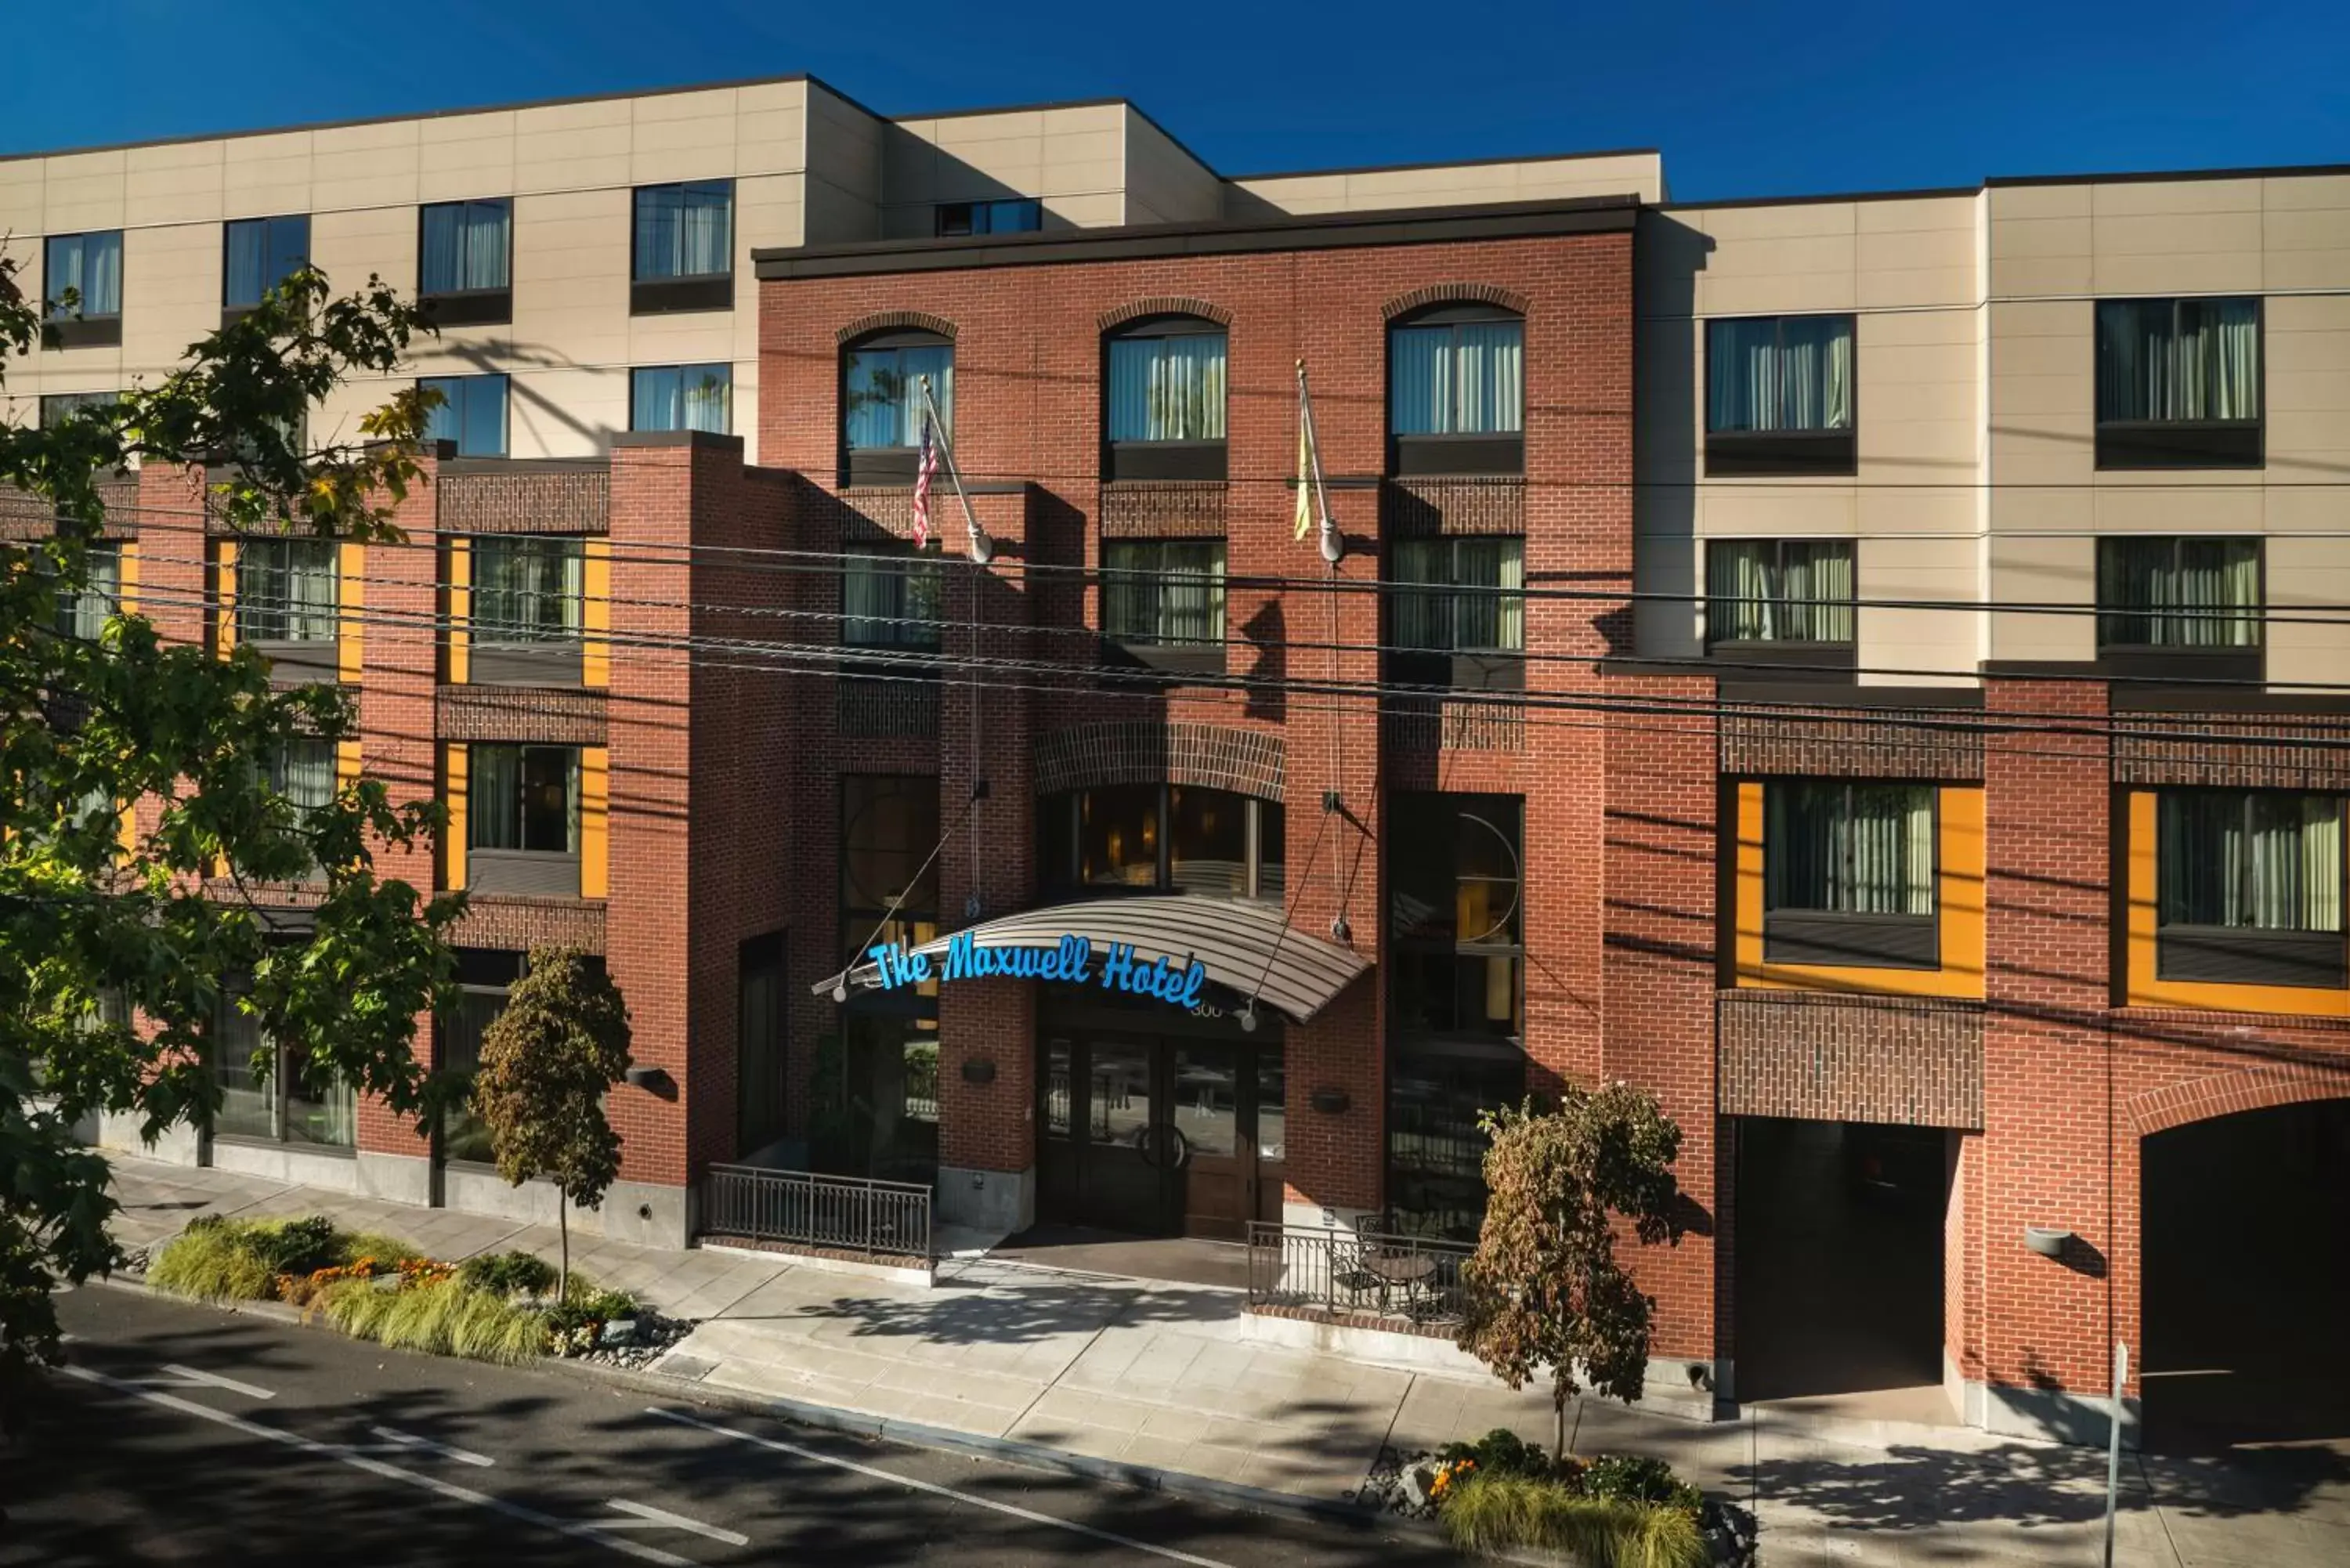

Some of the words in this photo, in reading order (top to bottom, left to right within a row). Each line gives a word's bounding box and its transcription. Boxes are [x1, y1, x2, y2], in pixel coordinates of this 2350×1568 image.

[868, 942, 931, 990] The
[942, 930, 1090, 982] Maxwell
[1102, 941, 1206, 1008] Hotel
